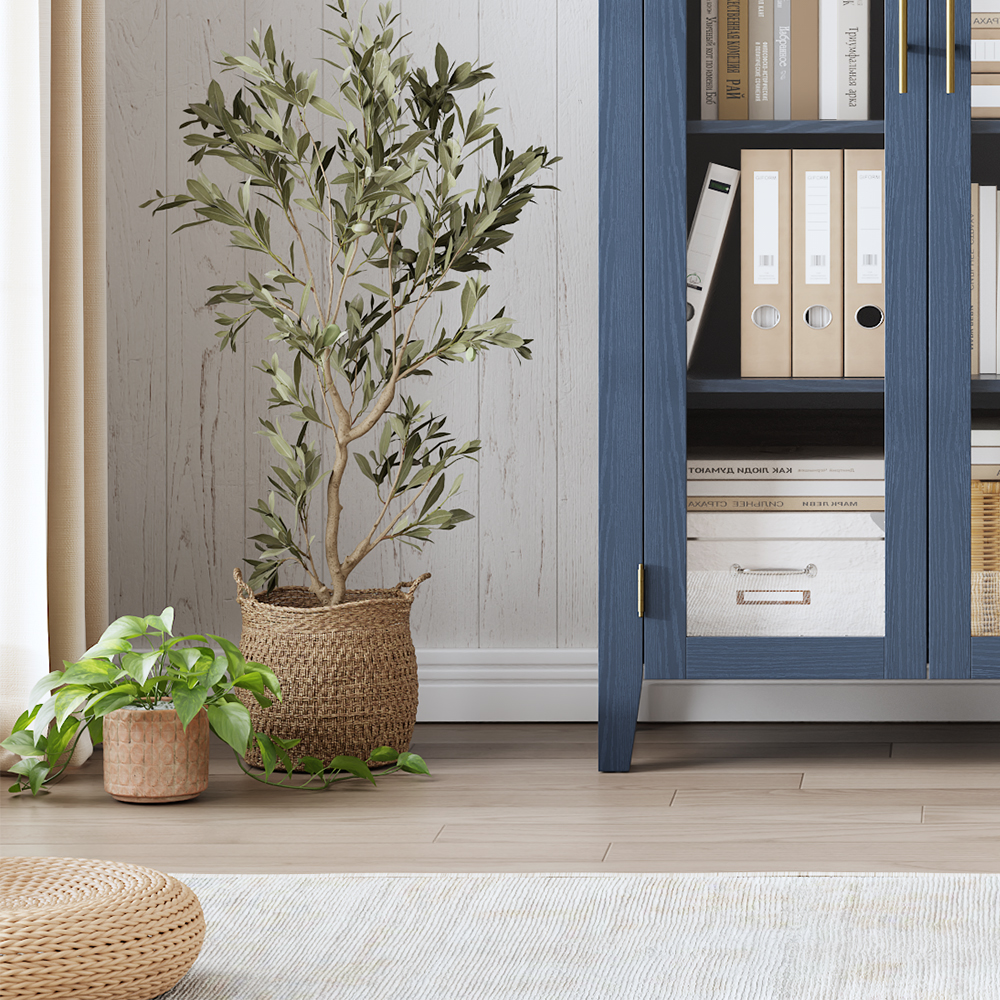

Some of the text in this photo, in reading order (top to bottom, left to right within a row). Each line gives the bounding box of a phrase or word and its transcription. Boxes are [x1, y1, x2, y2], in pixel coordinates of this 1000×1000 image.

[727, 40, 740, 73] КОМЕДИЯ
[845, 27, 859, 108] Триумфальная арка
[706, 92, 717, 105] Боб
[726, 79, 745, 100] РАЙ
